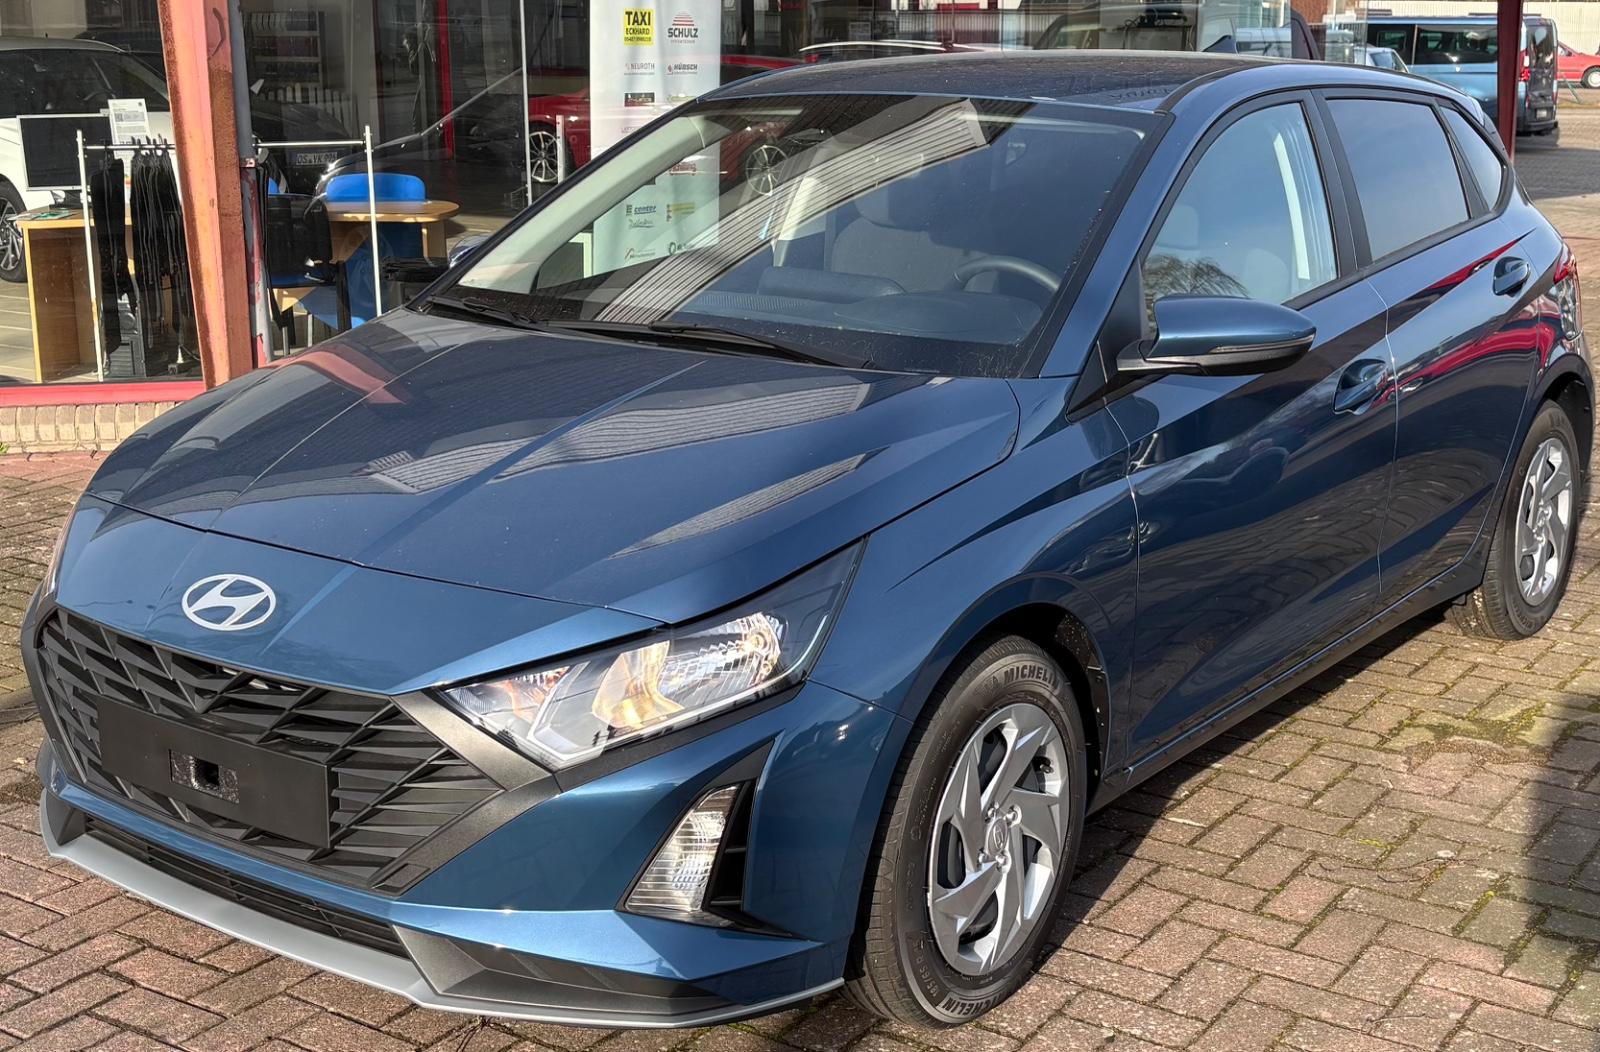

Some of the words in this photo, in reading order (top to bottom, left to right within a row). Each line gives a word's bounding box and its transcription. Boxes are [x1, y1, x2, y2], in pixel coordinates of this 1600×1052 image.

[625, 11, 651, 26] TAXI
[667, 27, 699, 38] SCHULZ
[1003, 664, 1061, 690] MICHELIN
